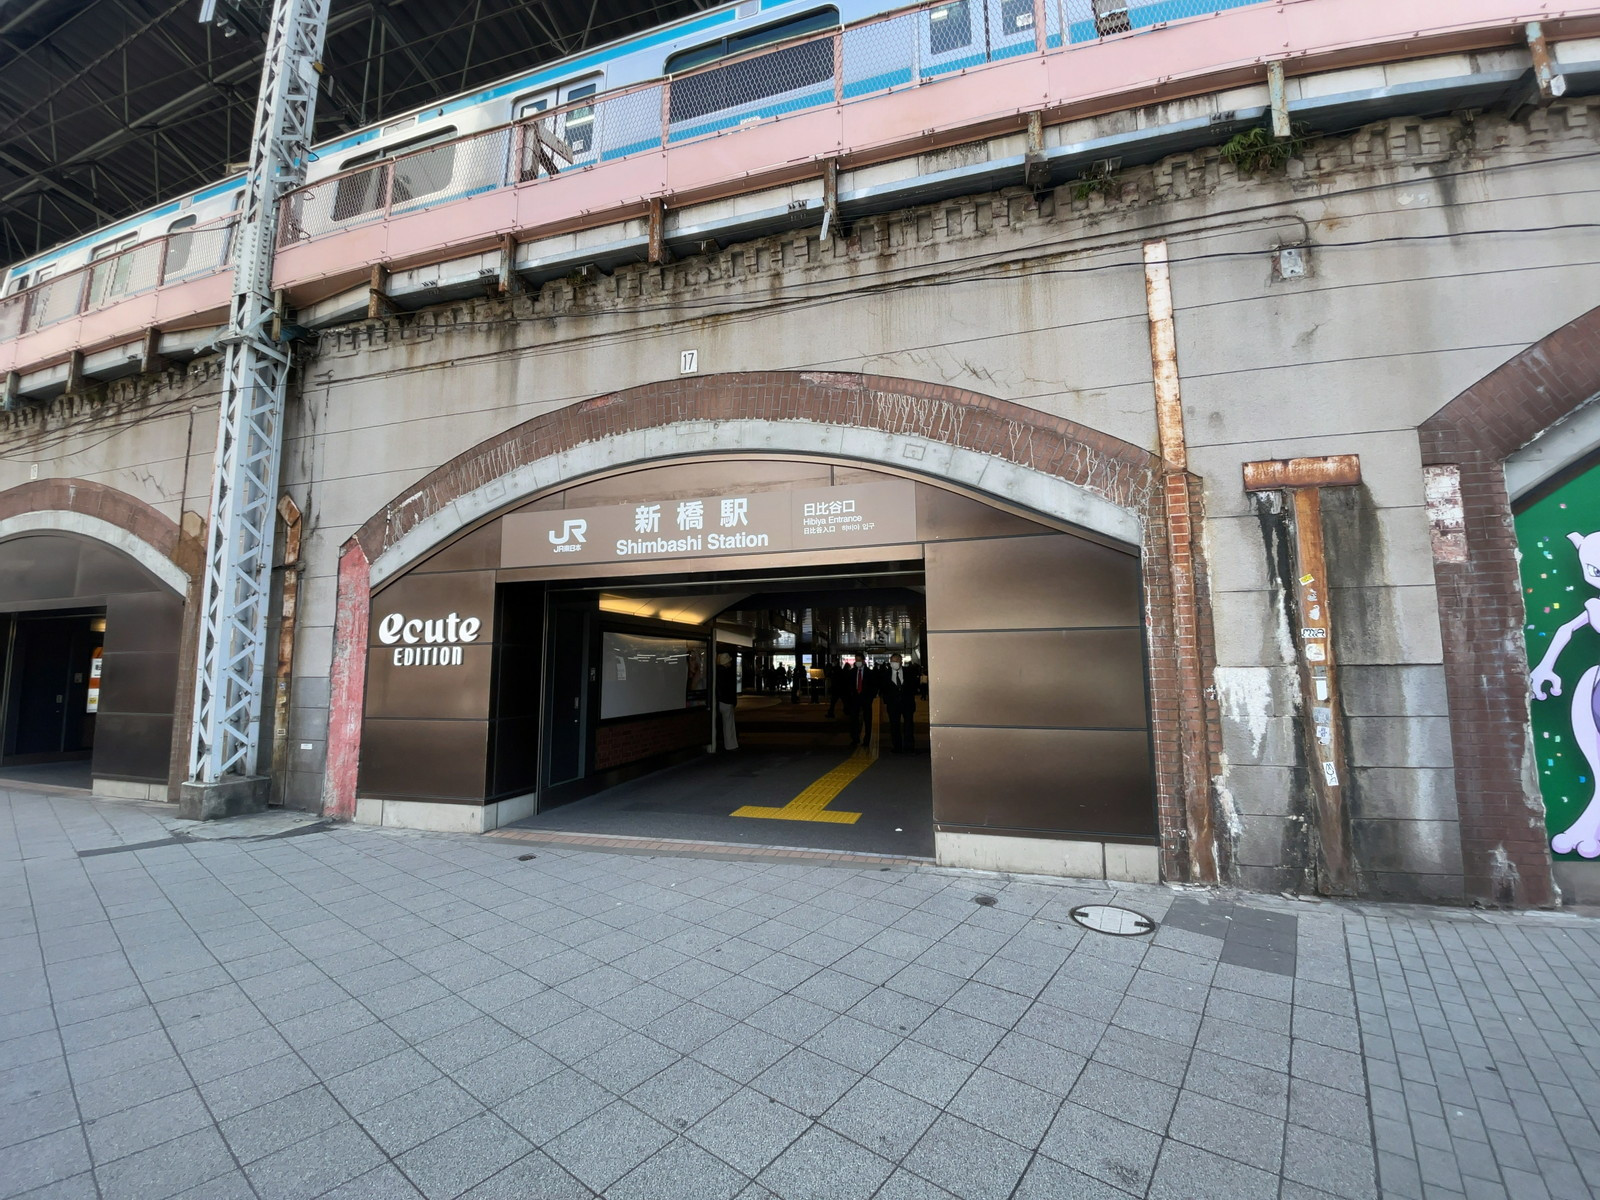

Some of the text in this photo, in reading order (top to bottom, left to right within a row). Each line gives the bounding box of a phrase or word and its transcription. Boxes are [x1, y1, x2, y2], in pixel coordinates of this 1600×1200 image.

[683, 353, 695, 370] 17
[634, 498, 749, 534] 新橋駅
[804, 499, 855, 516] 日比谷口
[803, 515, 863, 527] Hibiya Entrance
[803, 525, 836, 535] 日比谷入口
[548, 519, 587, 545] JR
[616, 531, 769, 556] Shimbashi Station
[378, 612, 481, 645] ecute
[393, 646, 463, 667] EDITION
